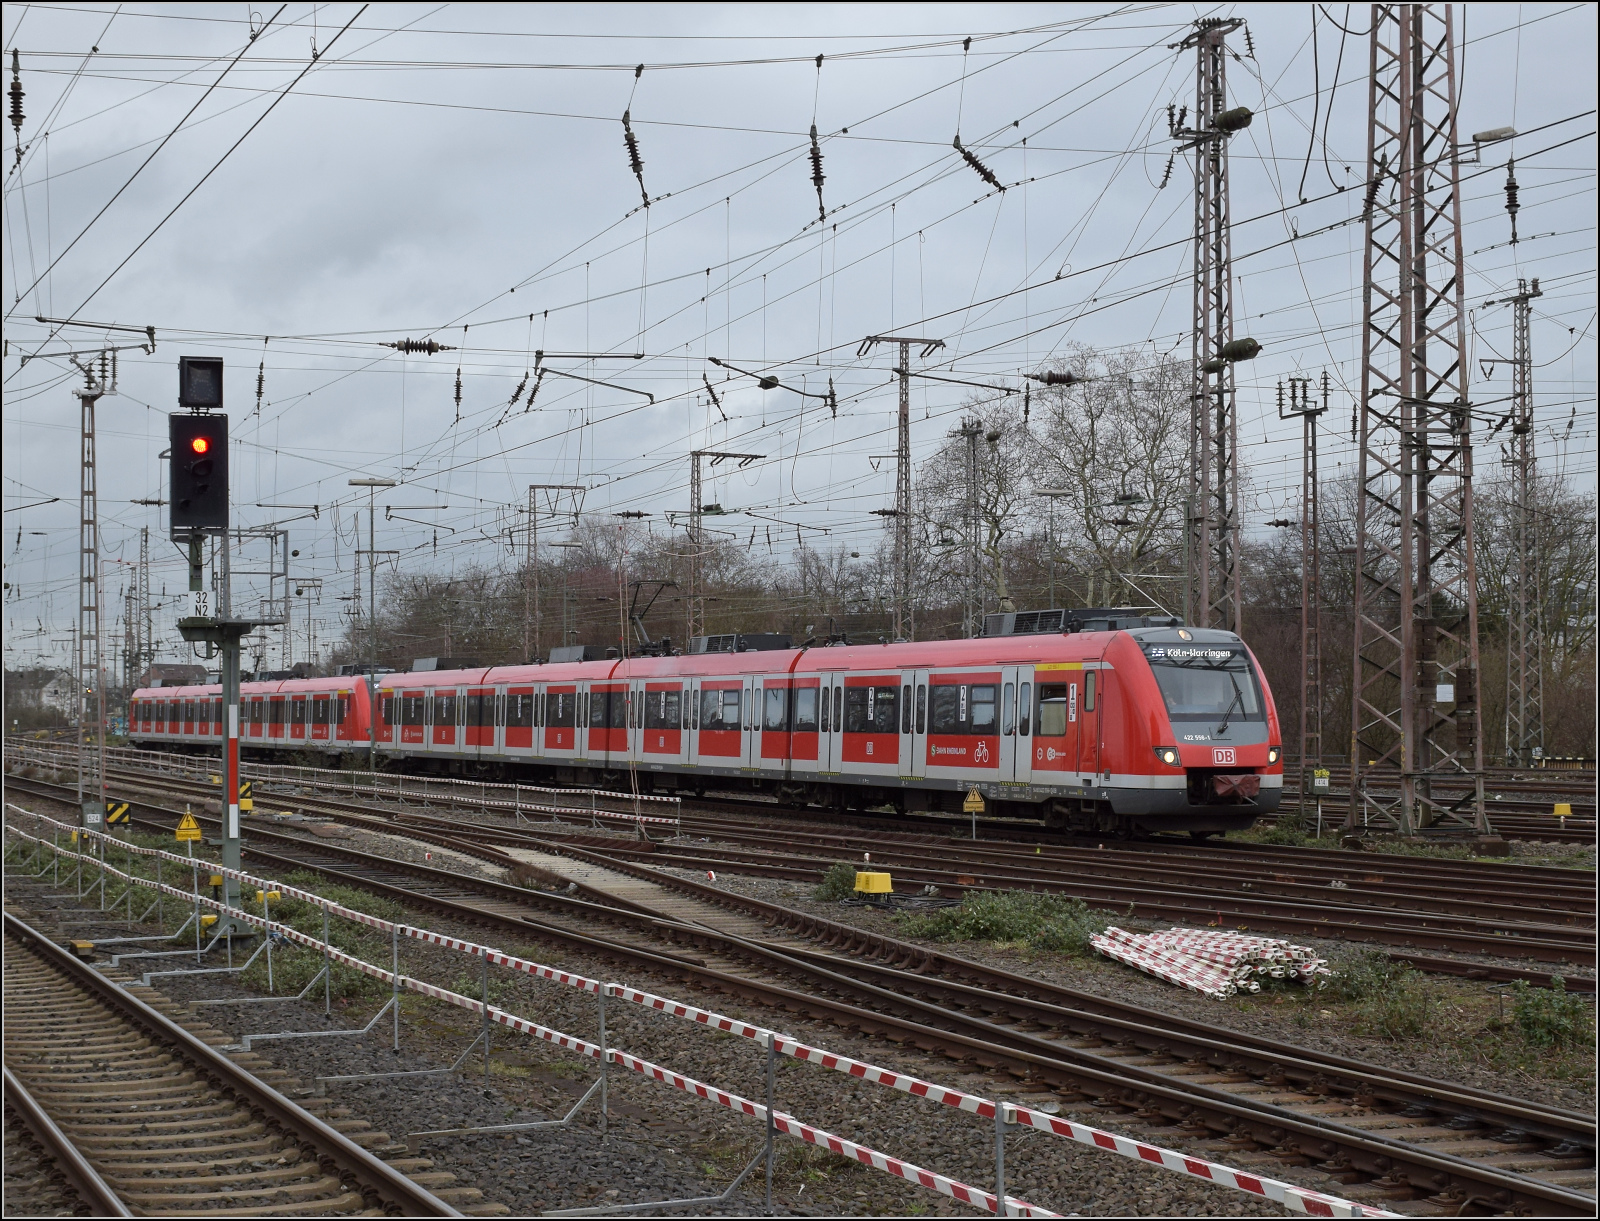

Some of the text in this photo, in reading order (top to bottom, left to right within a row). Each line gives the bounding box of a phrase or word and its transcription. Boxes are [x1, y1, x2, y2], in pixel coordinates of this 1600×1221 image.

[195, 591, 208, 604] 32
[195, 604, 208, 617] N2
[1215, 750, 1234, 762] DB
[88, 814, 100, 823] 524
